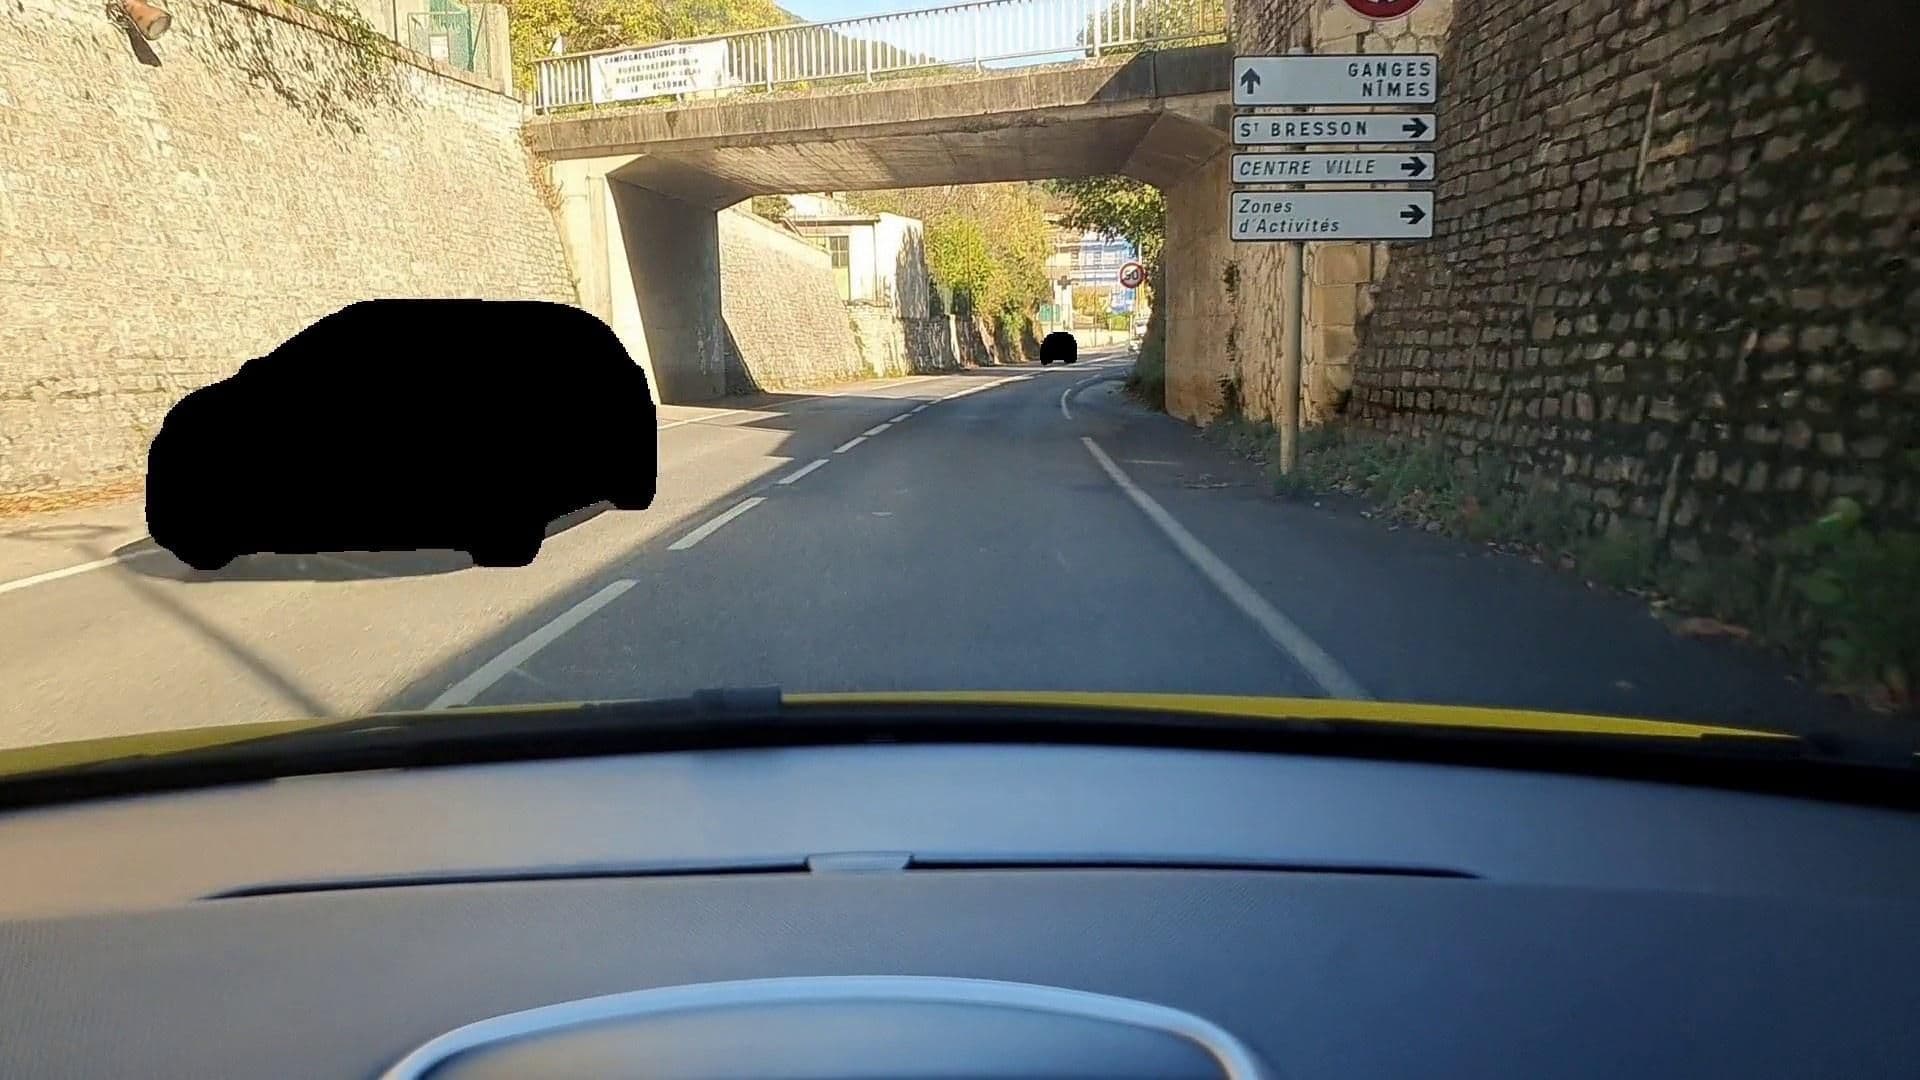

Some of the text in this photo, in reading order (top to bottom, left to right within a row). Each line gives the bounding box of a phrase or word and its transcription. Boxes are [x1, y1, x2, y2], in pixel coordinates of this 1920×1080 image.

[1348, 62, 1431, 77] GANGES
[1362, 79, 1431, 97] NÎMES
[1271, 121, 1368, 137] BRESSON
[1239, 159, 1376, 176] CENTRE VILLE
[1238, 199, 1293, 214] Zones
[1238, 217, 1340, 234] d'Activités
